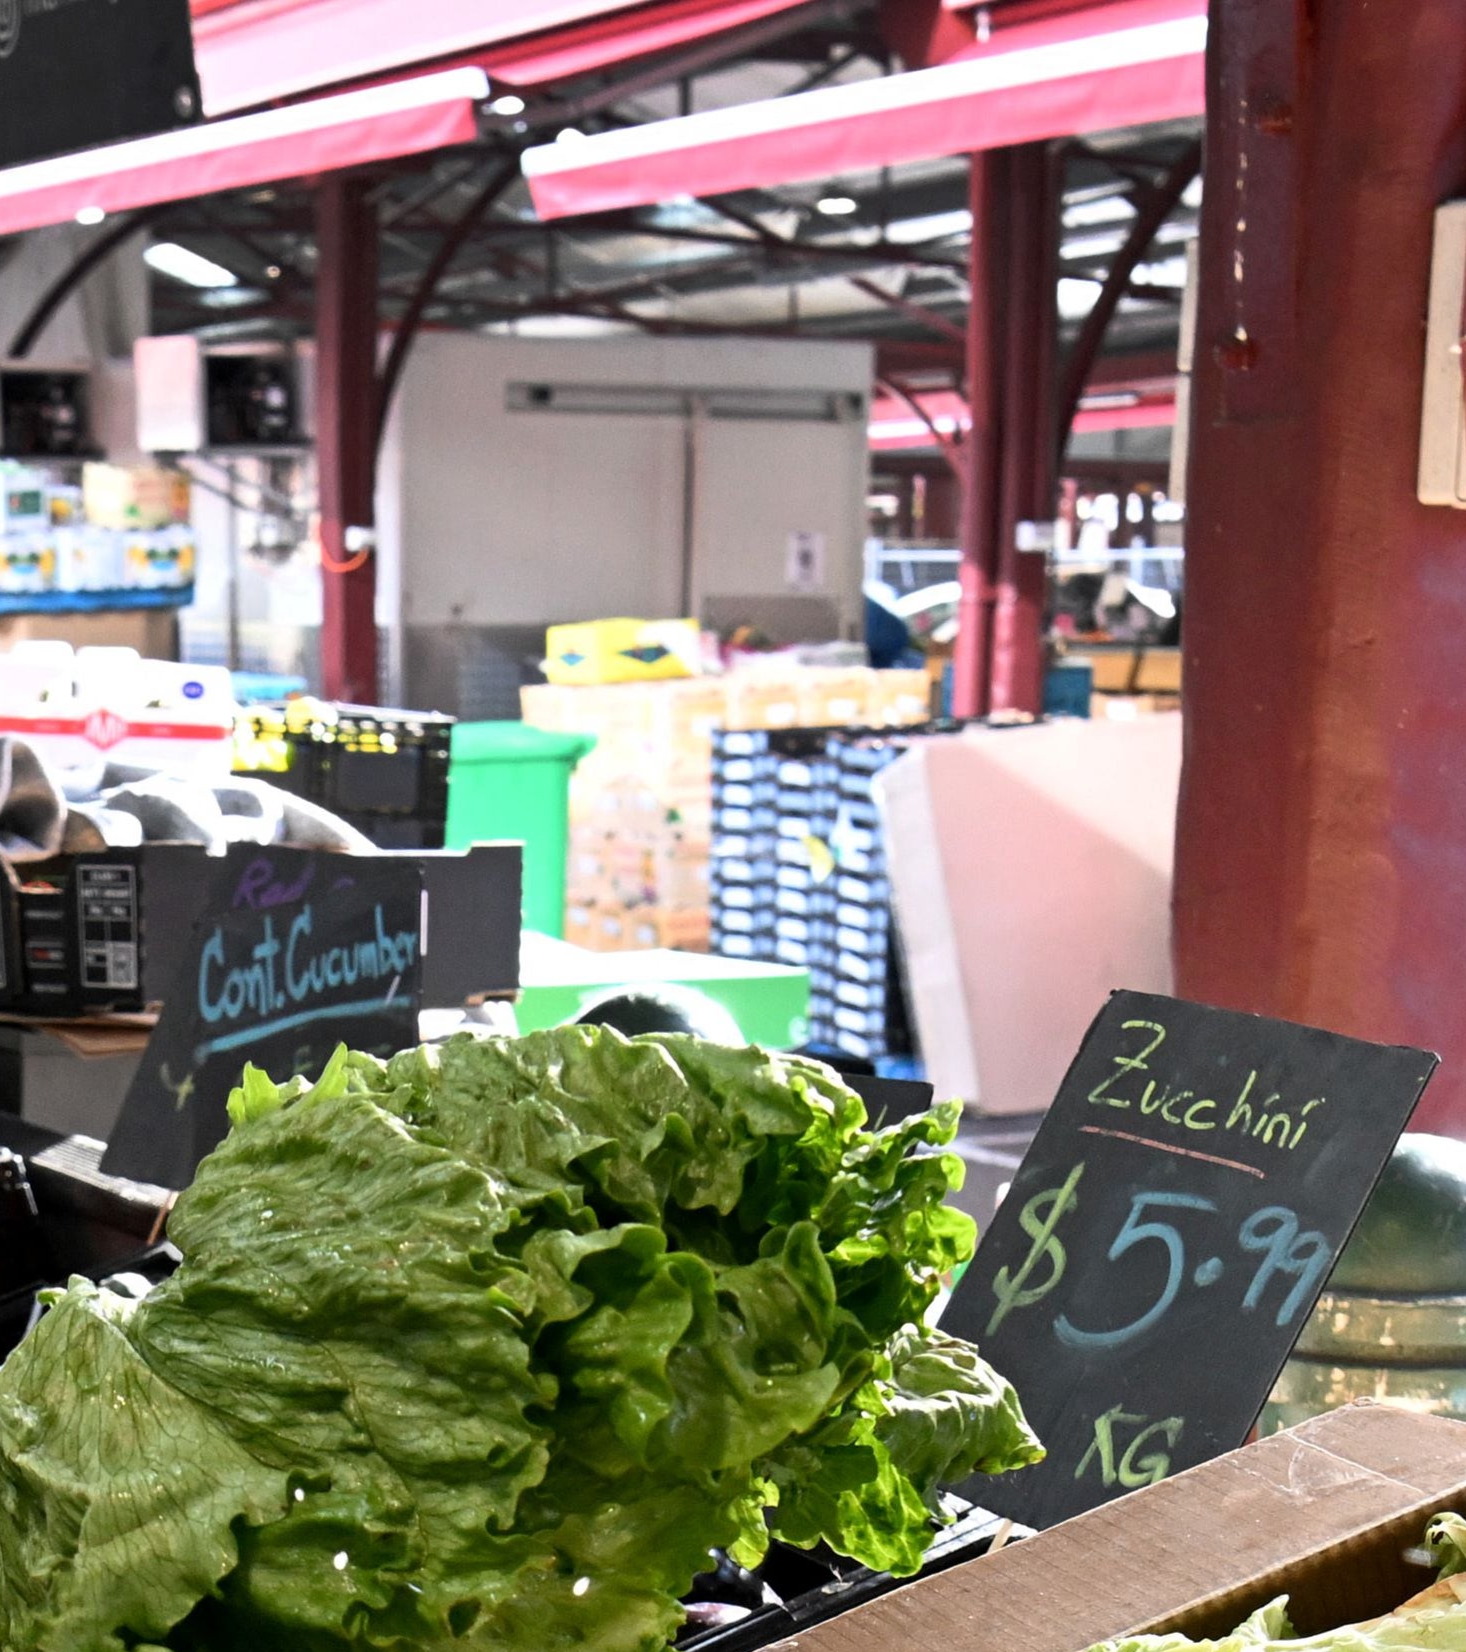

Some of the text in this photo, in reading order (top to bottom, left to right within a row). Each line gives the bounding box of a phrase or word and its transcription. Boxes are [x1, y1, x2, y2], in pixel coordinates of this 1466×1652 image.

[284, 902, 418, 1002] Cucumber
[1087, 1018, 1327, 1151] Zucchini
[984, 1160, 1332, 1350] $5.99
[1074, 1403, 1185, 1490] KG
